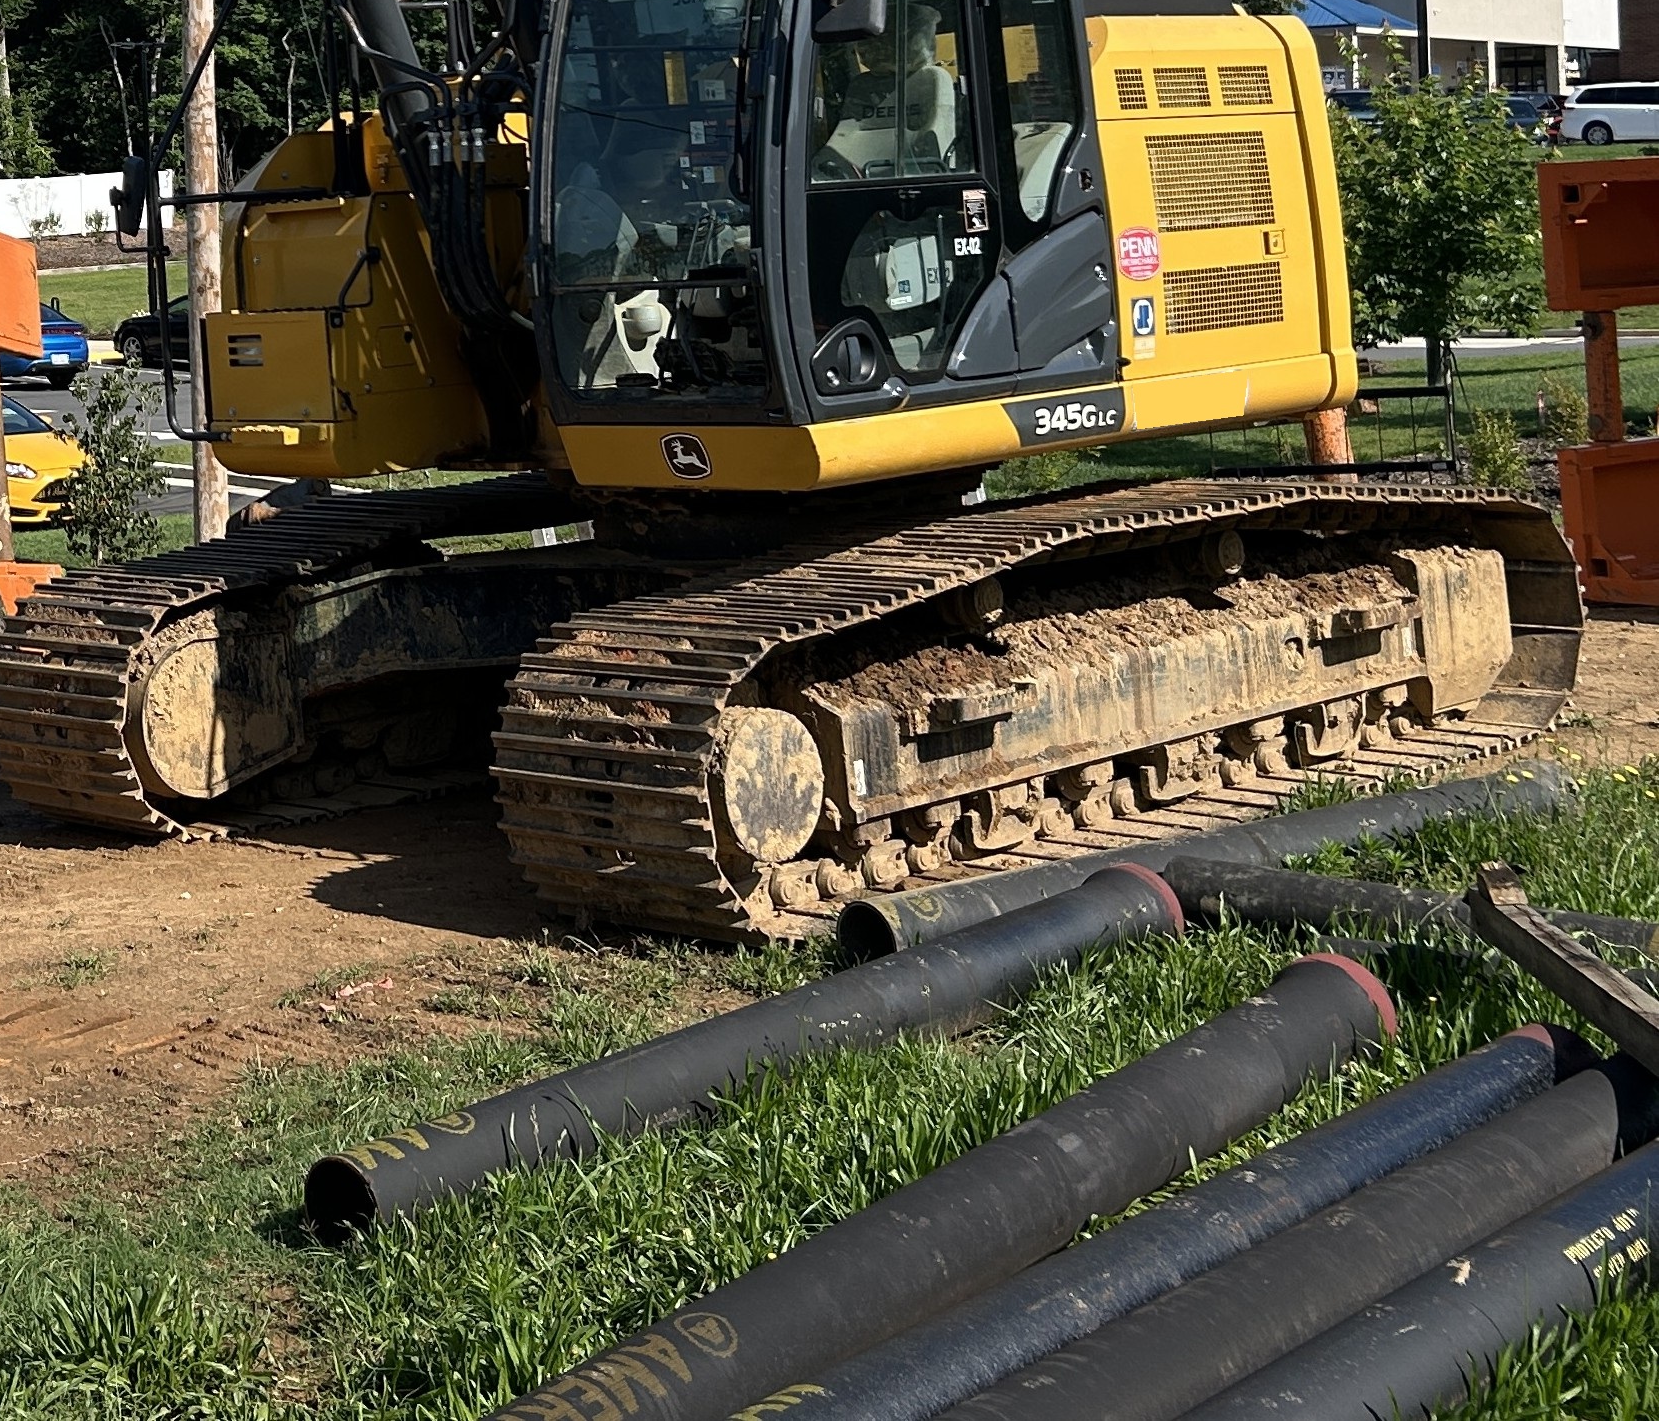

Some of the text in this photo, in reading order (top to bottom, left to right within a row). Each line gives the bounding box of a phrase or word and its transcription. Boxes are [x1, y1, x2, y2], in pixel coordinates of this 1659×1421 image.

[862, 104, 920, 119] DEEE
[954, 237, 982, 256] EX-02
[1119, 236, 1158, 258] PENN
[1563, 1226, 1616, 1265] PROTECTO
